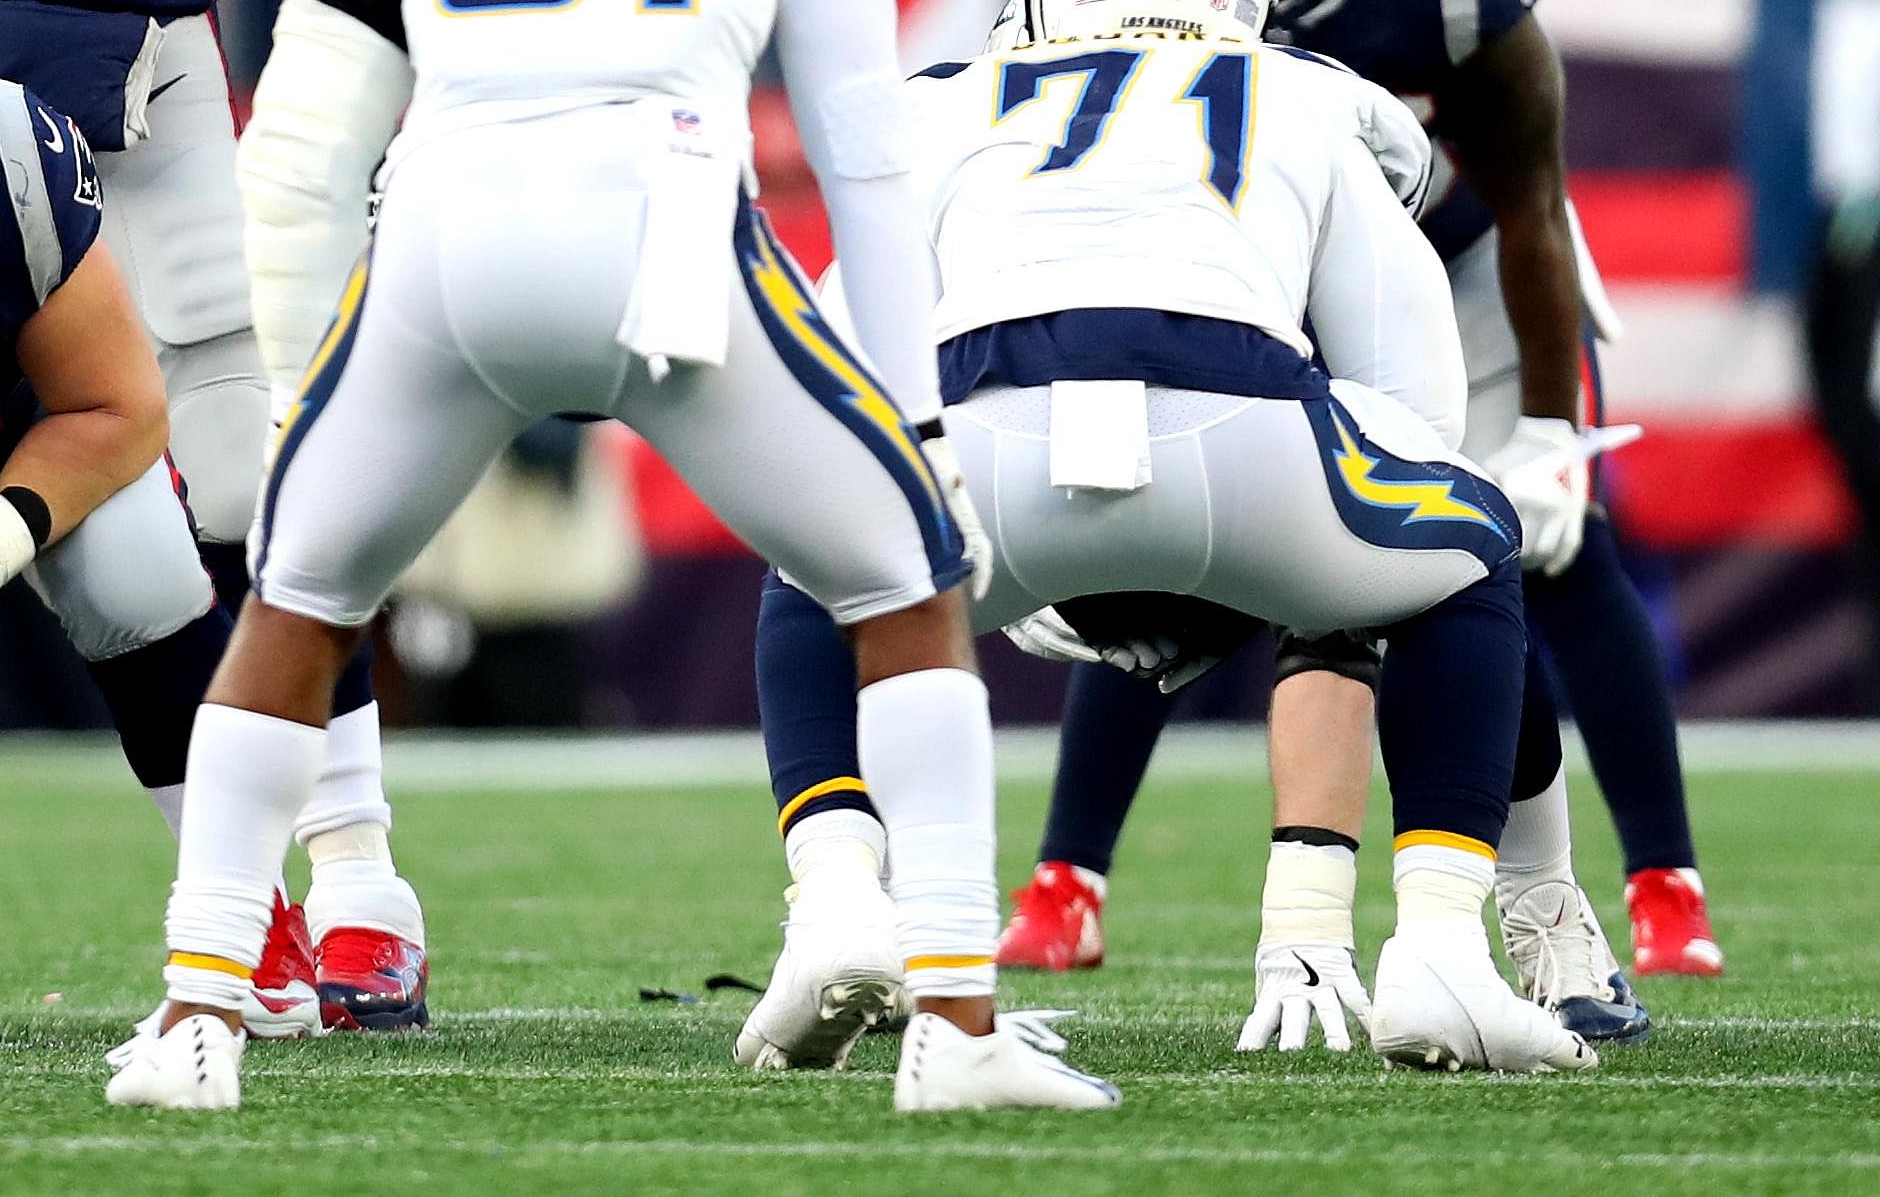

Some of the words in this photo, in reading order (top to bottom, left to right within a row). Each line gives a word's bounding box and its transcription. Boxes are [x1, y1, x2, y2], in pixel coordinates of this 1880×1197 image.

[1121, 16, 1145, 28] LOS
[1146, 16, 1203, 34] ANGELES
[990, 44, 1259, 218] 71
